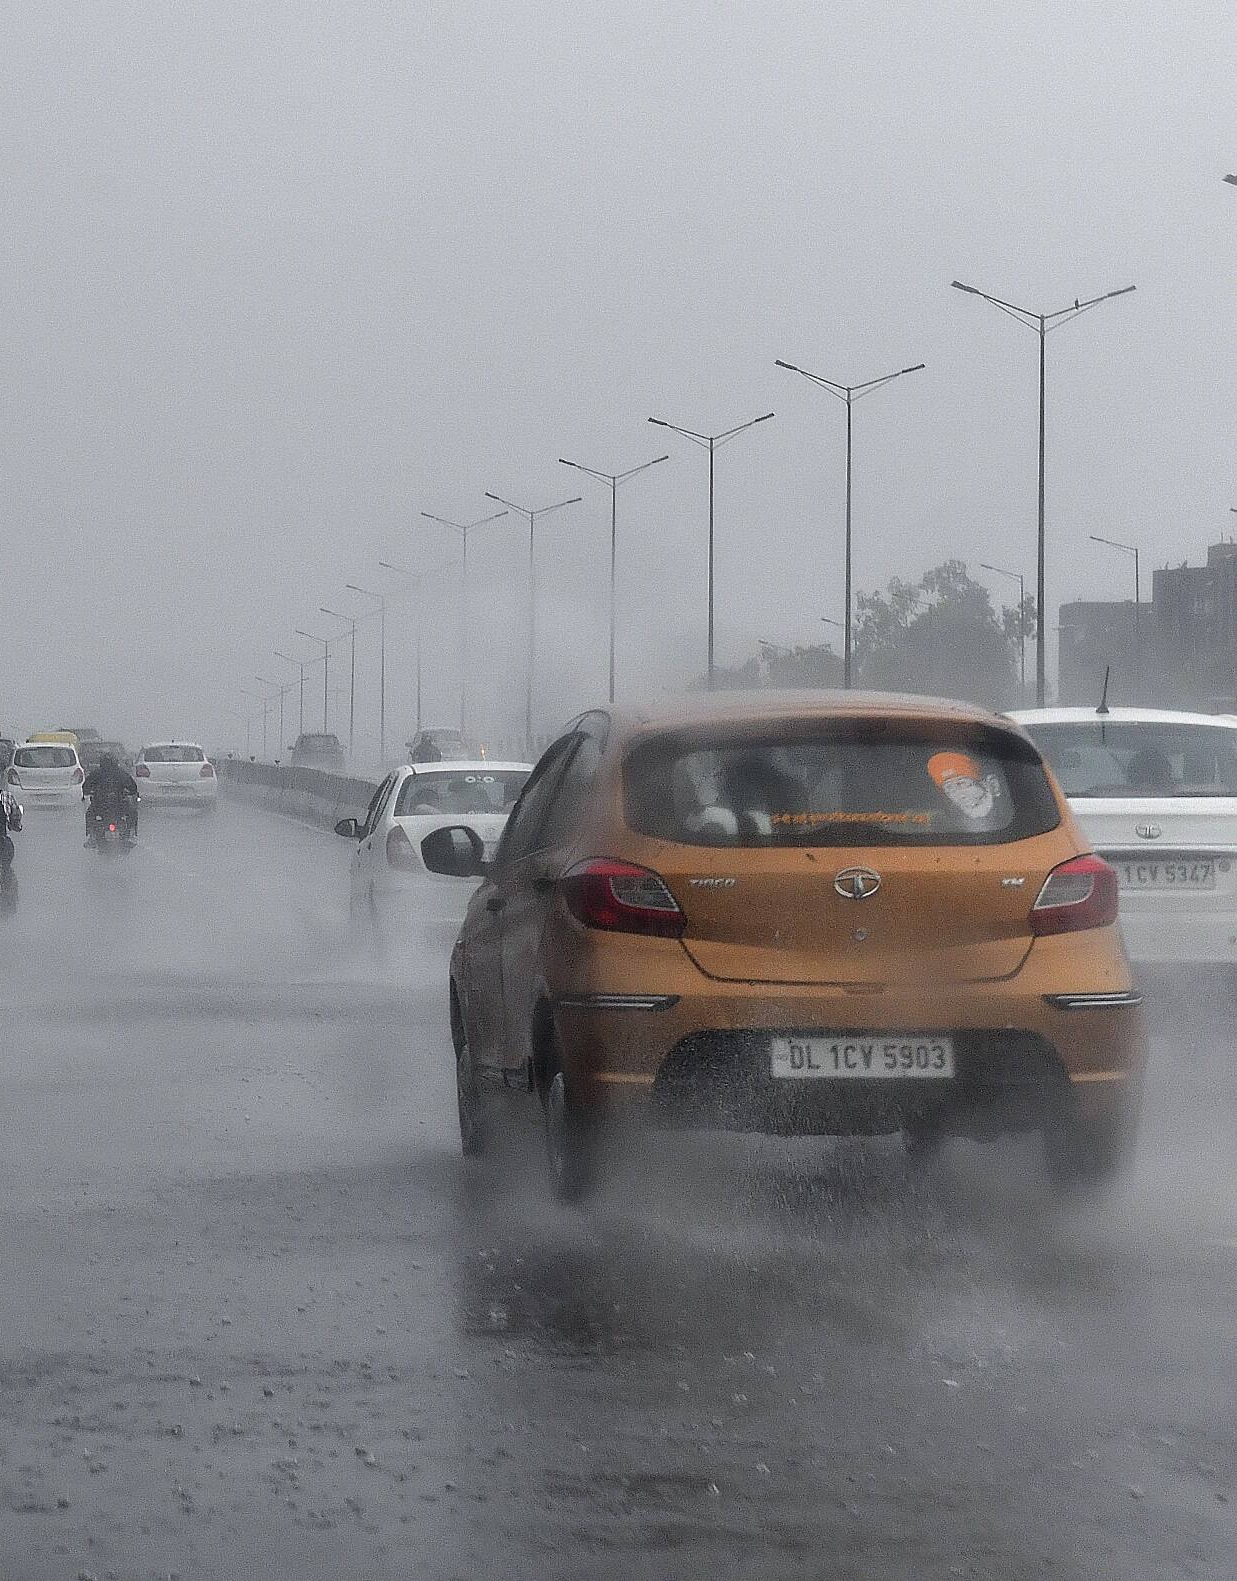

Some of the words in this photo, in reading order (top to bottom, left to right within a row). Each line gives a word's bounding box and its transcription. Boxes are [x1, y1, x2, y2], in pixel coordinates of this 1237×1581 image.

[1125, 864, 1159, 883] 1CV
[789, 1045, 821, 1070] DL
[830, 1044, 874, 1070] 1CV
[883, 1044, 946, 1070] 5903
